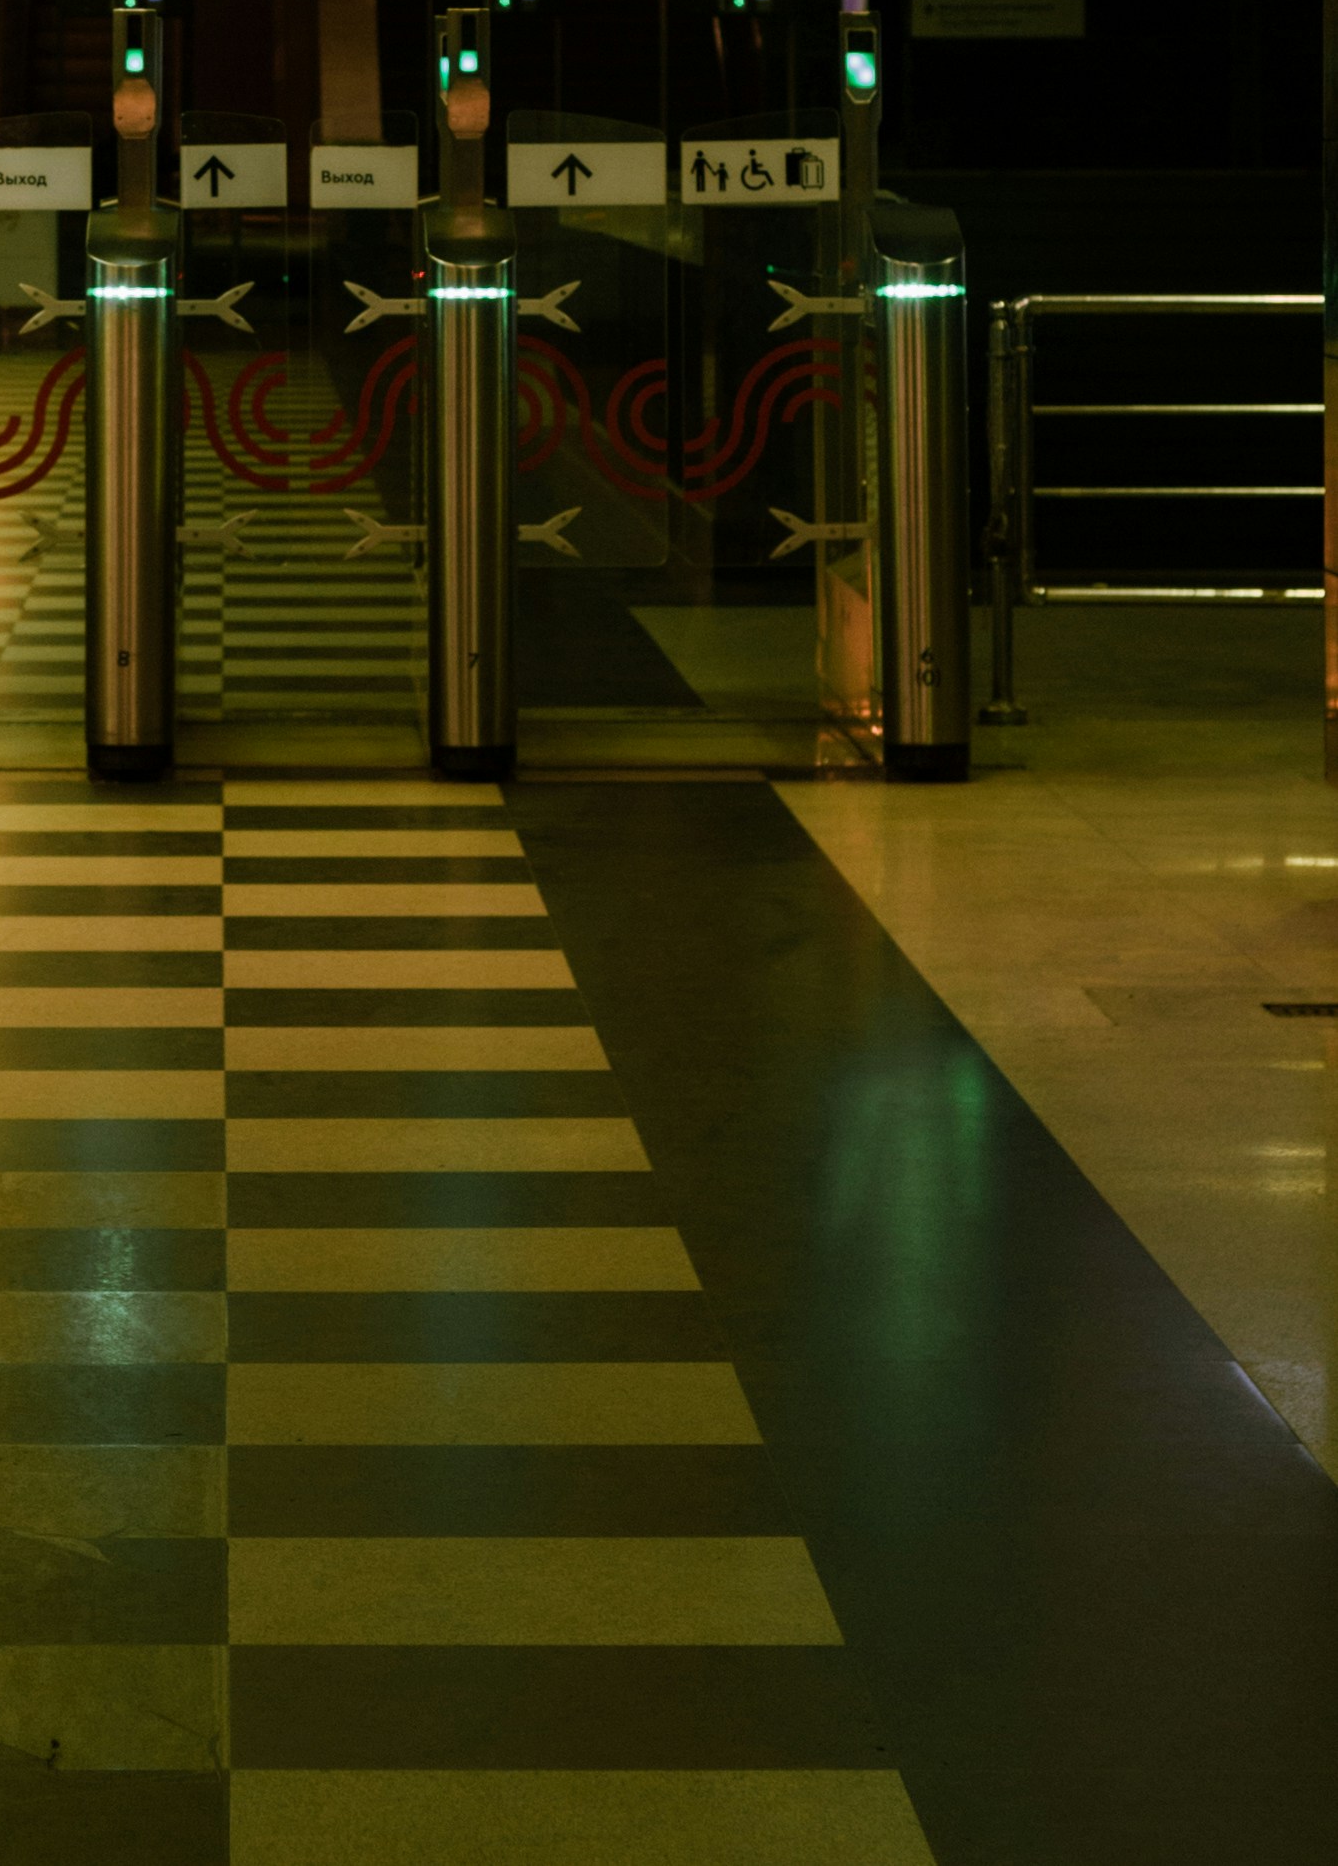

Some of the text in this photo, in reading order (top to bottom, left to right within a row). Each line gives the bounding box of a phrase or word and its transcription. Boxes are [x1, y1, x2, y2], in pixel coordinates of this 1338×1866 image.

[321, 170, 374, 185] Выход
[118, 650, 130, 666] 8
[468, 652, 480, 668] 7
